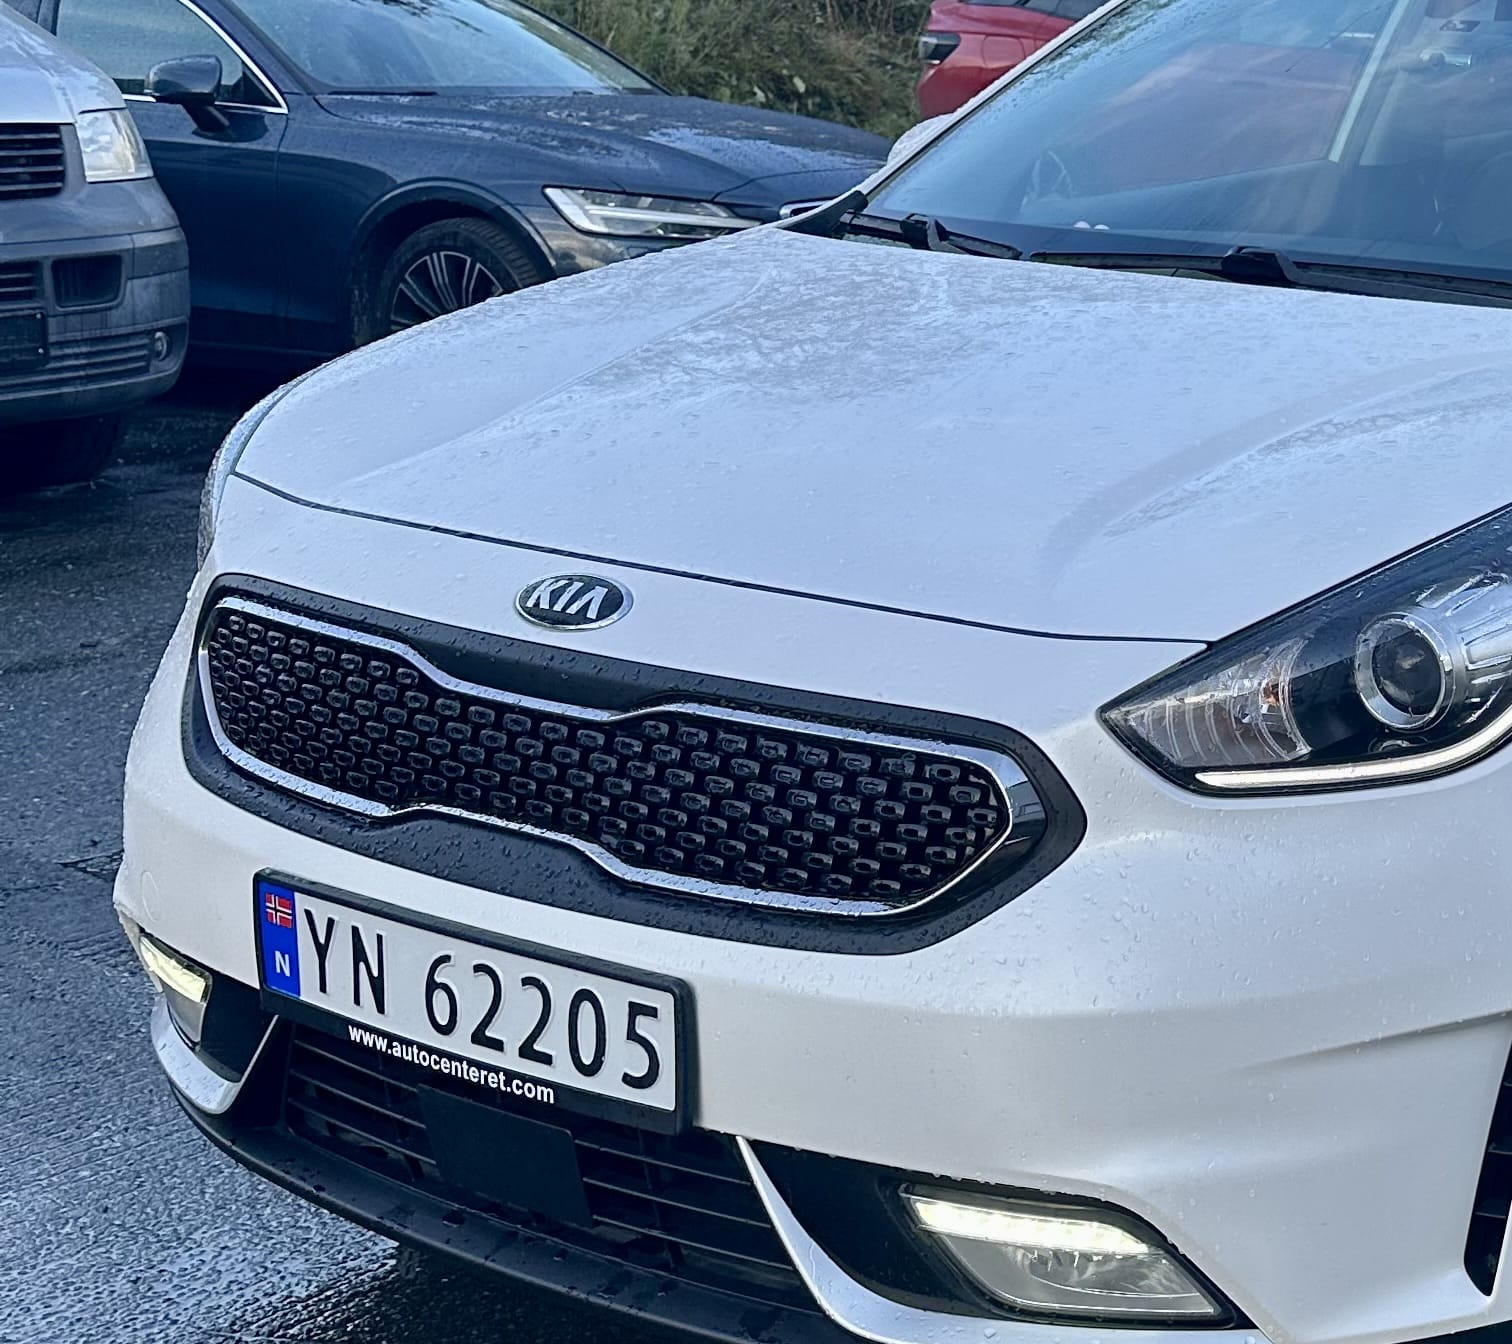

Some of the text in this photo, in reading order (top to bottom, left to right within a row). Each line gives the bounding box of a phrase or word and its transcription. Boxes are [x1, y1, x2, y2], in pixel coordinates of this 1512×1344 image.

[525, 578, 609, 620] KIA
[274, 950, 291, 978] N
[304, 908, 661, 1090] YN 62205
[348, 1024, 555, 1105] www.autocenteret.com
